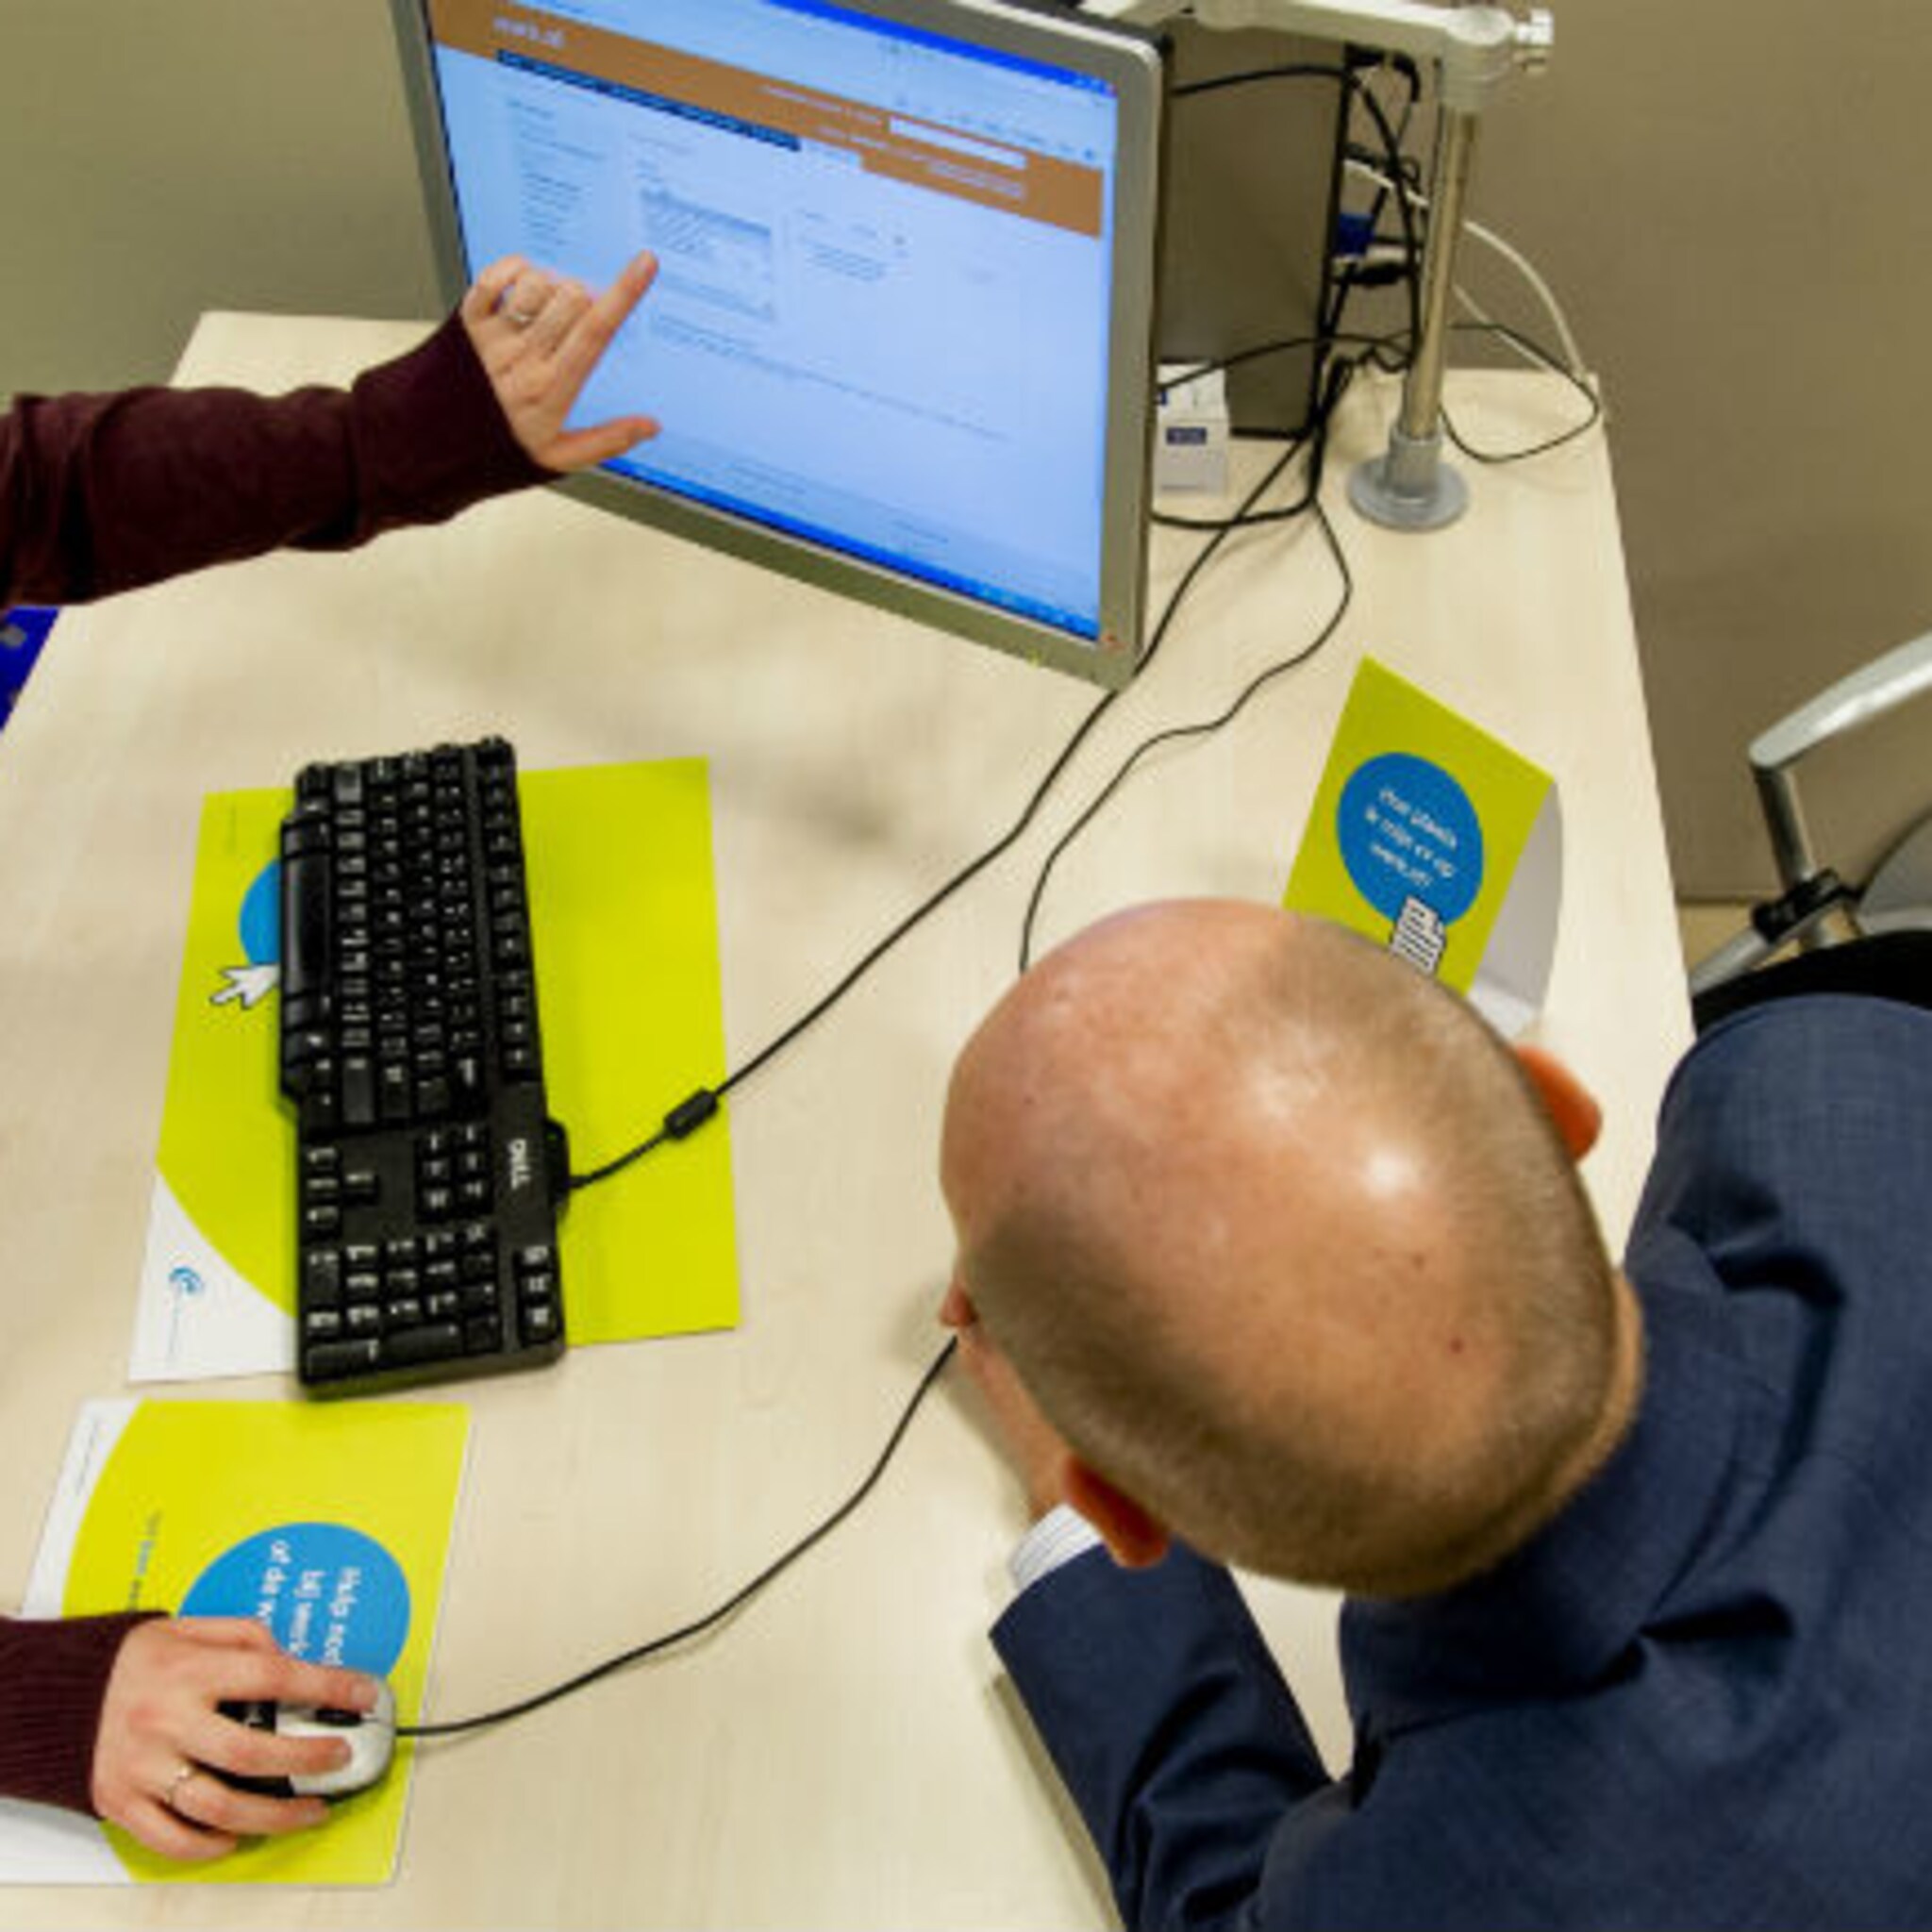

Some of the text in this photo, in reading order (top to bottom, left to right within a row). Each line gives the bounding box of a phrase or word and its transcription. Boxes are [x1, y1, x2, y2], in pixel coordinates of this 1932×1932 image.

[508, 1138, 530, 1190] DELL
[269, 1539, 291, 1564] of
[261, 1566, 286, 1594] de
[292, 1569, 326, 1599] bij
[328, 1566, 361, 1618] Hulp
